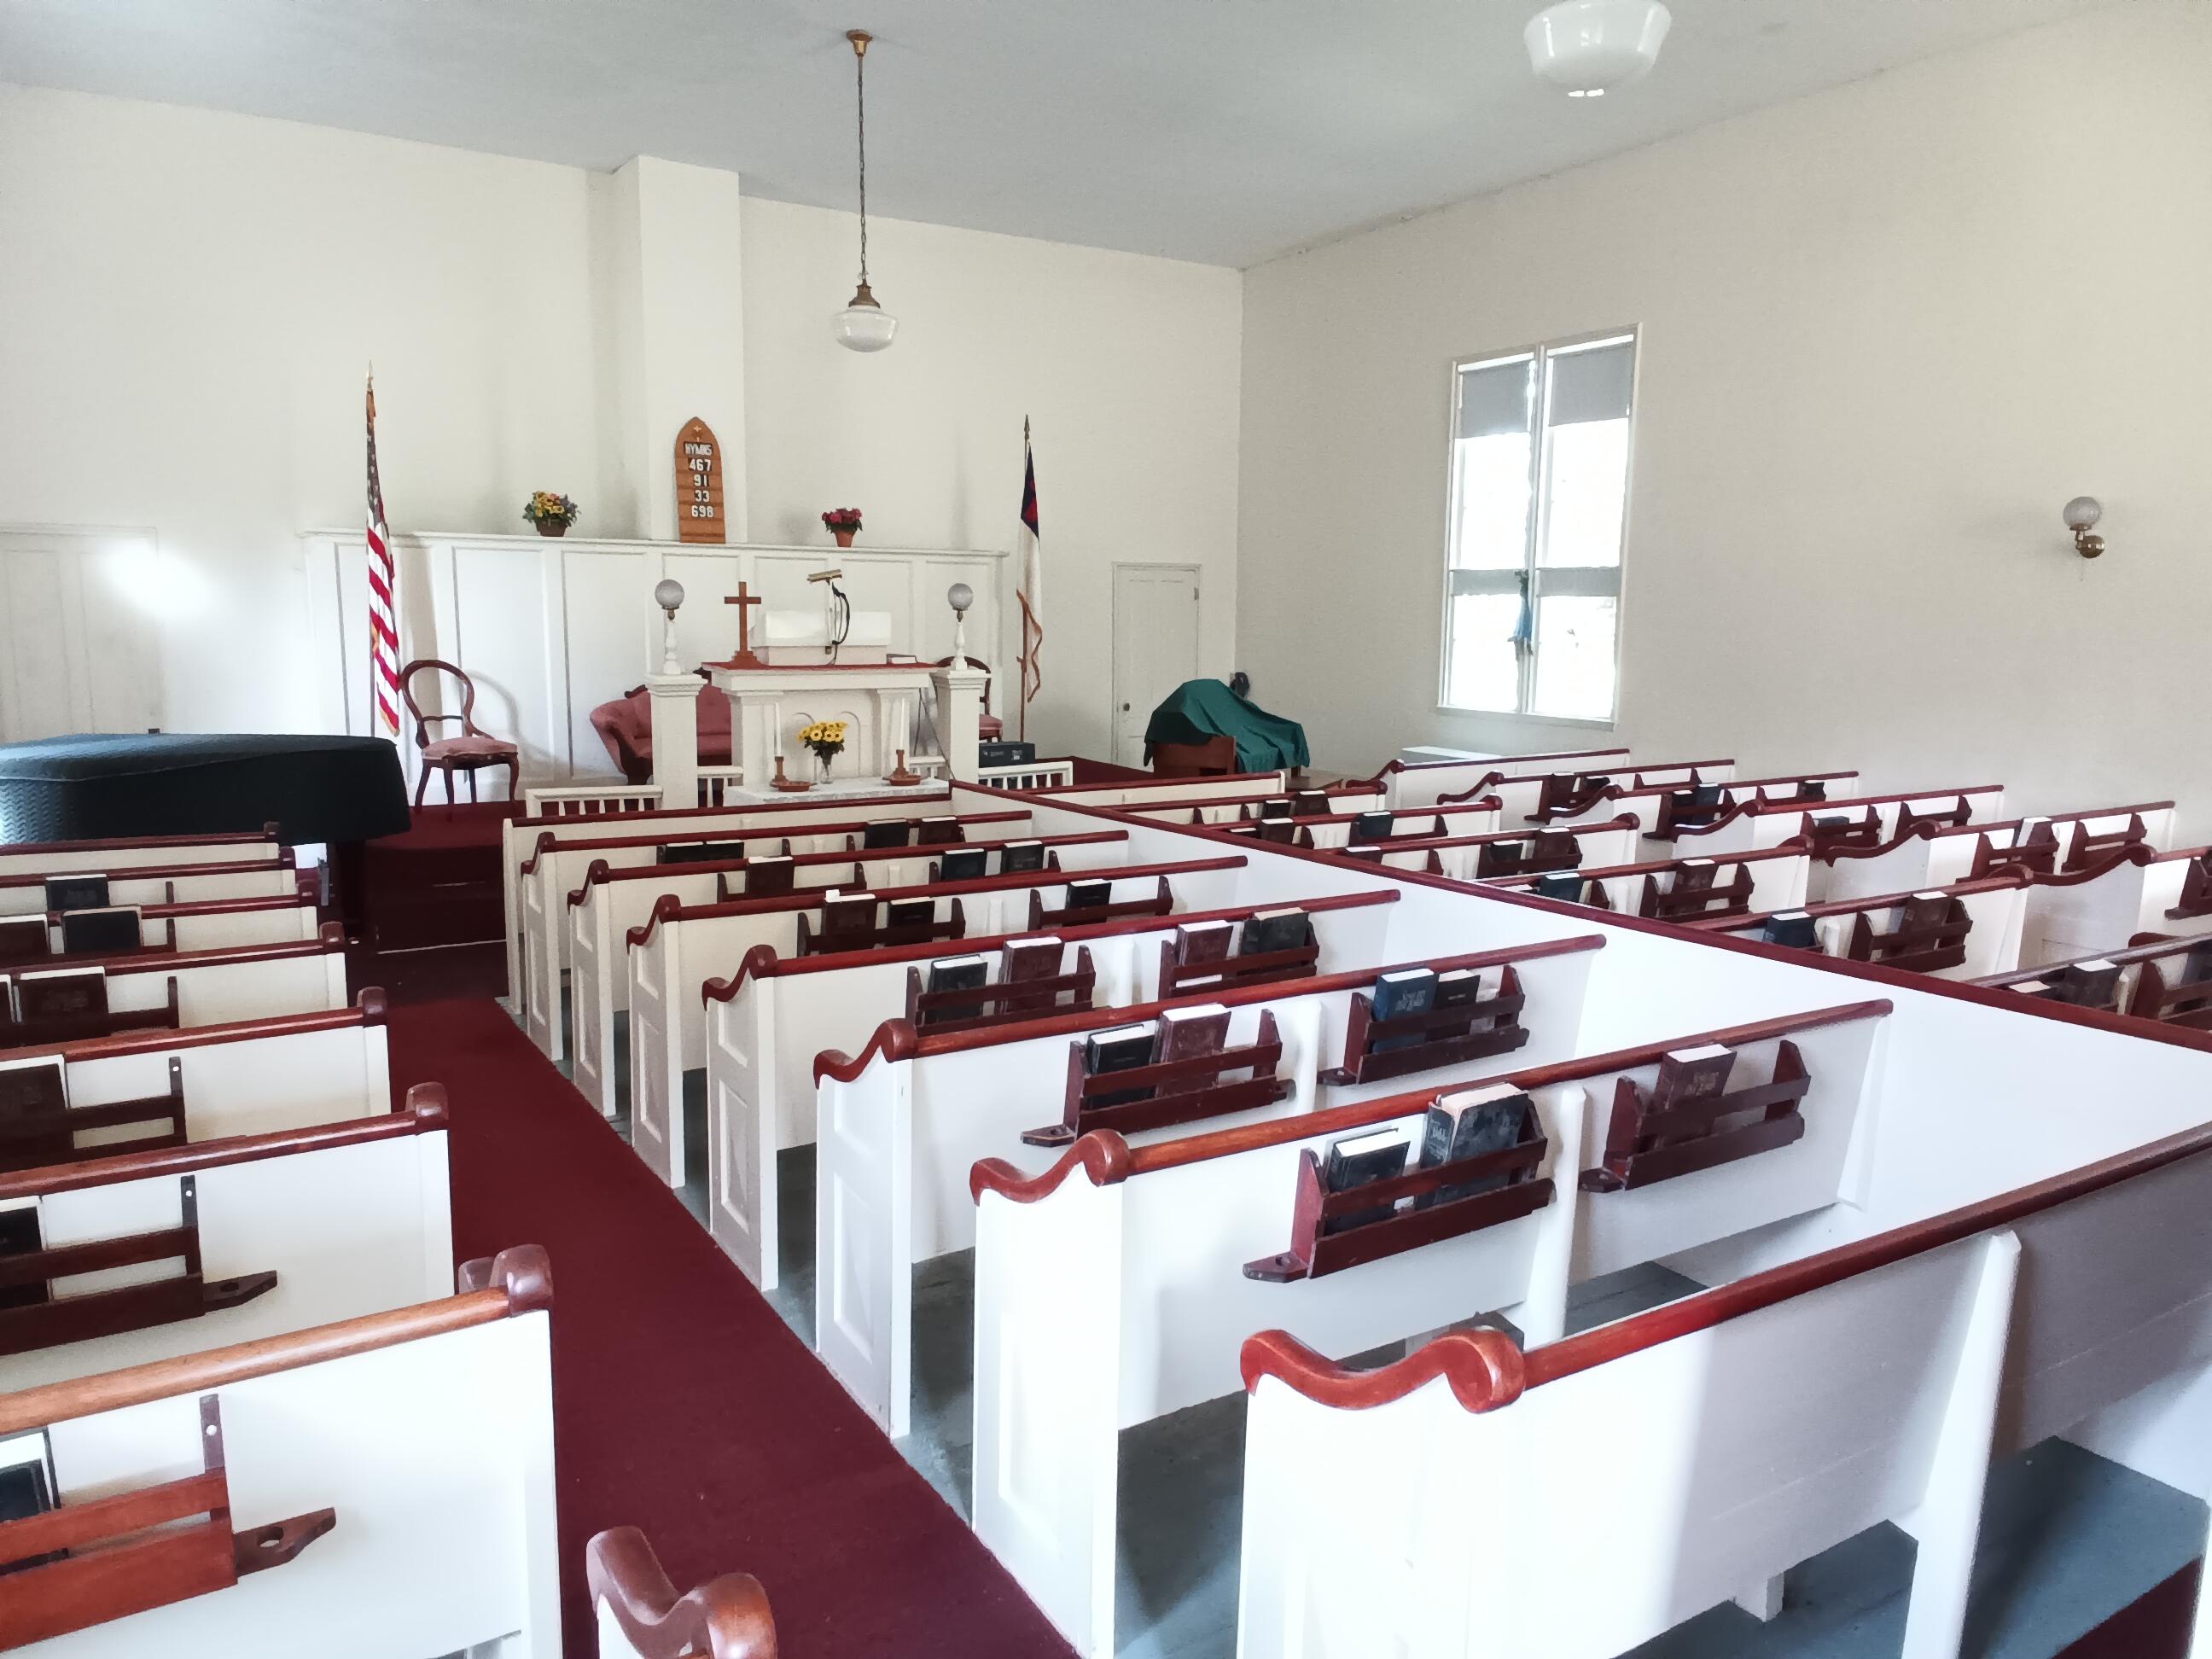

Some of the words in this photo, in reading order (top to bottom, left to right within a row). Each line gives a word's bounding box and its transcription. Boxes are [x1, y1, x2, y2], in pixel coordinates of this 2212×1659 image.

[690, 458, 712, 472] 467
[694, 474, 707, 487] 91
[695, 489, 710, 503] 33
[691, 505, 714, 518] 698
